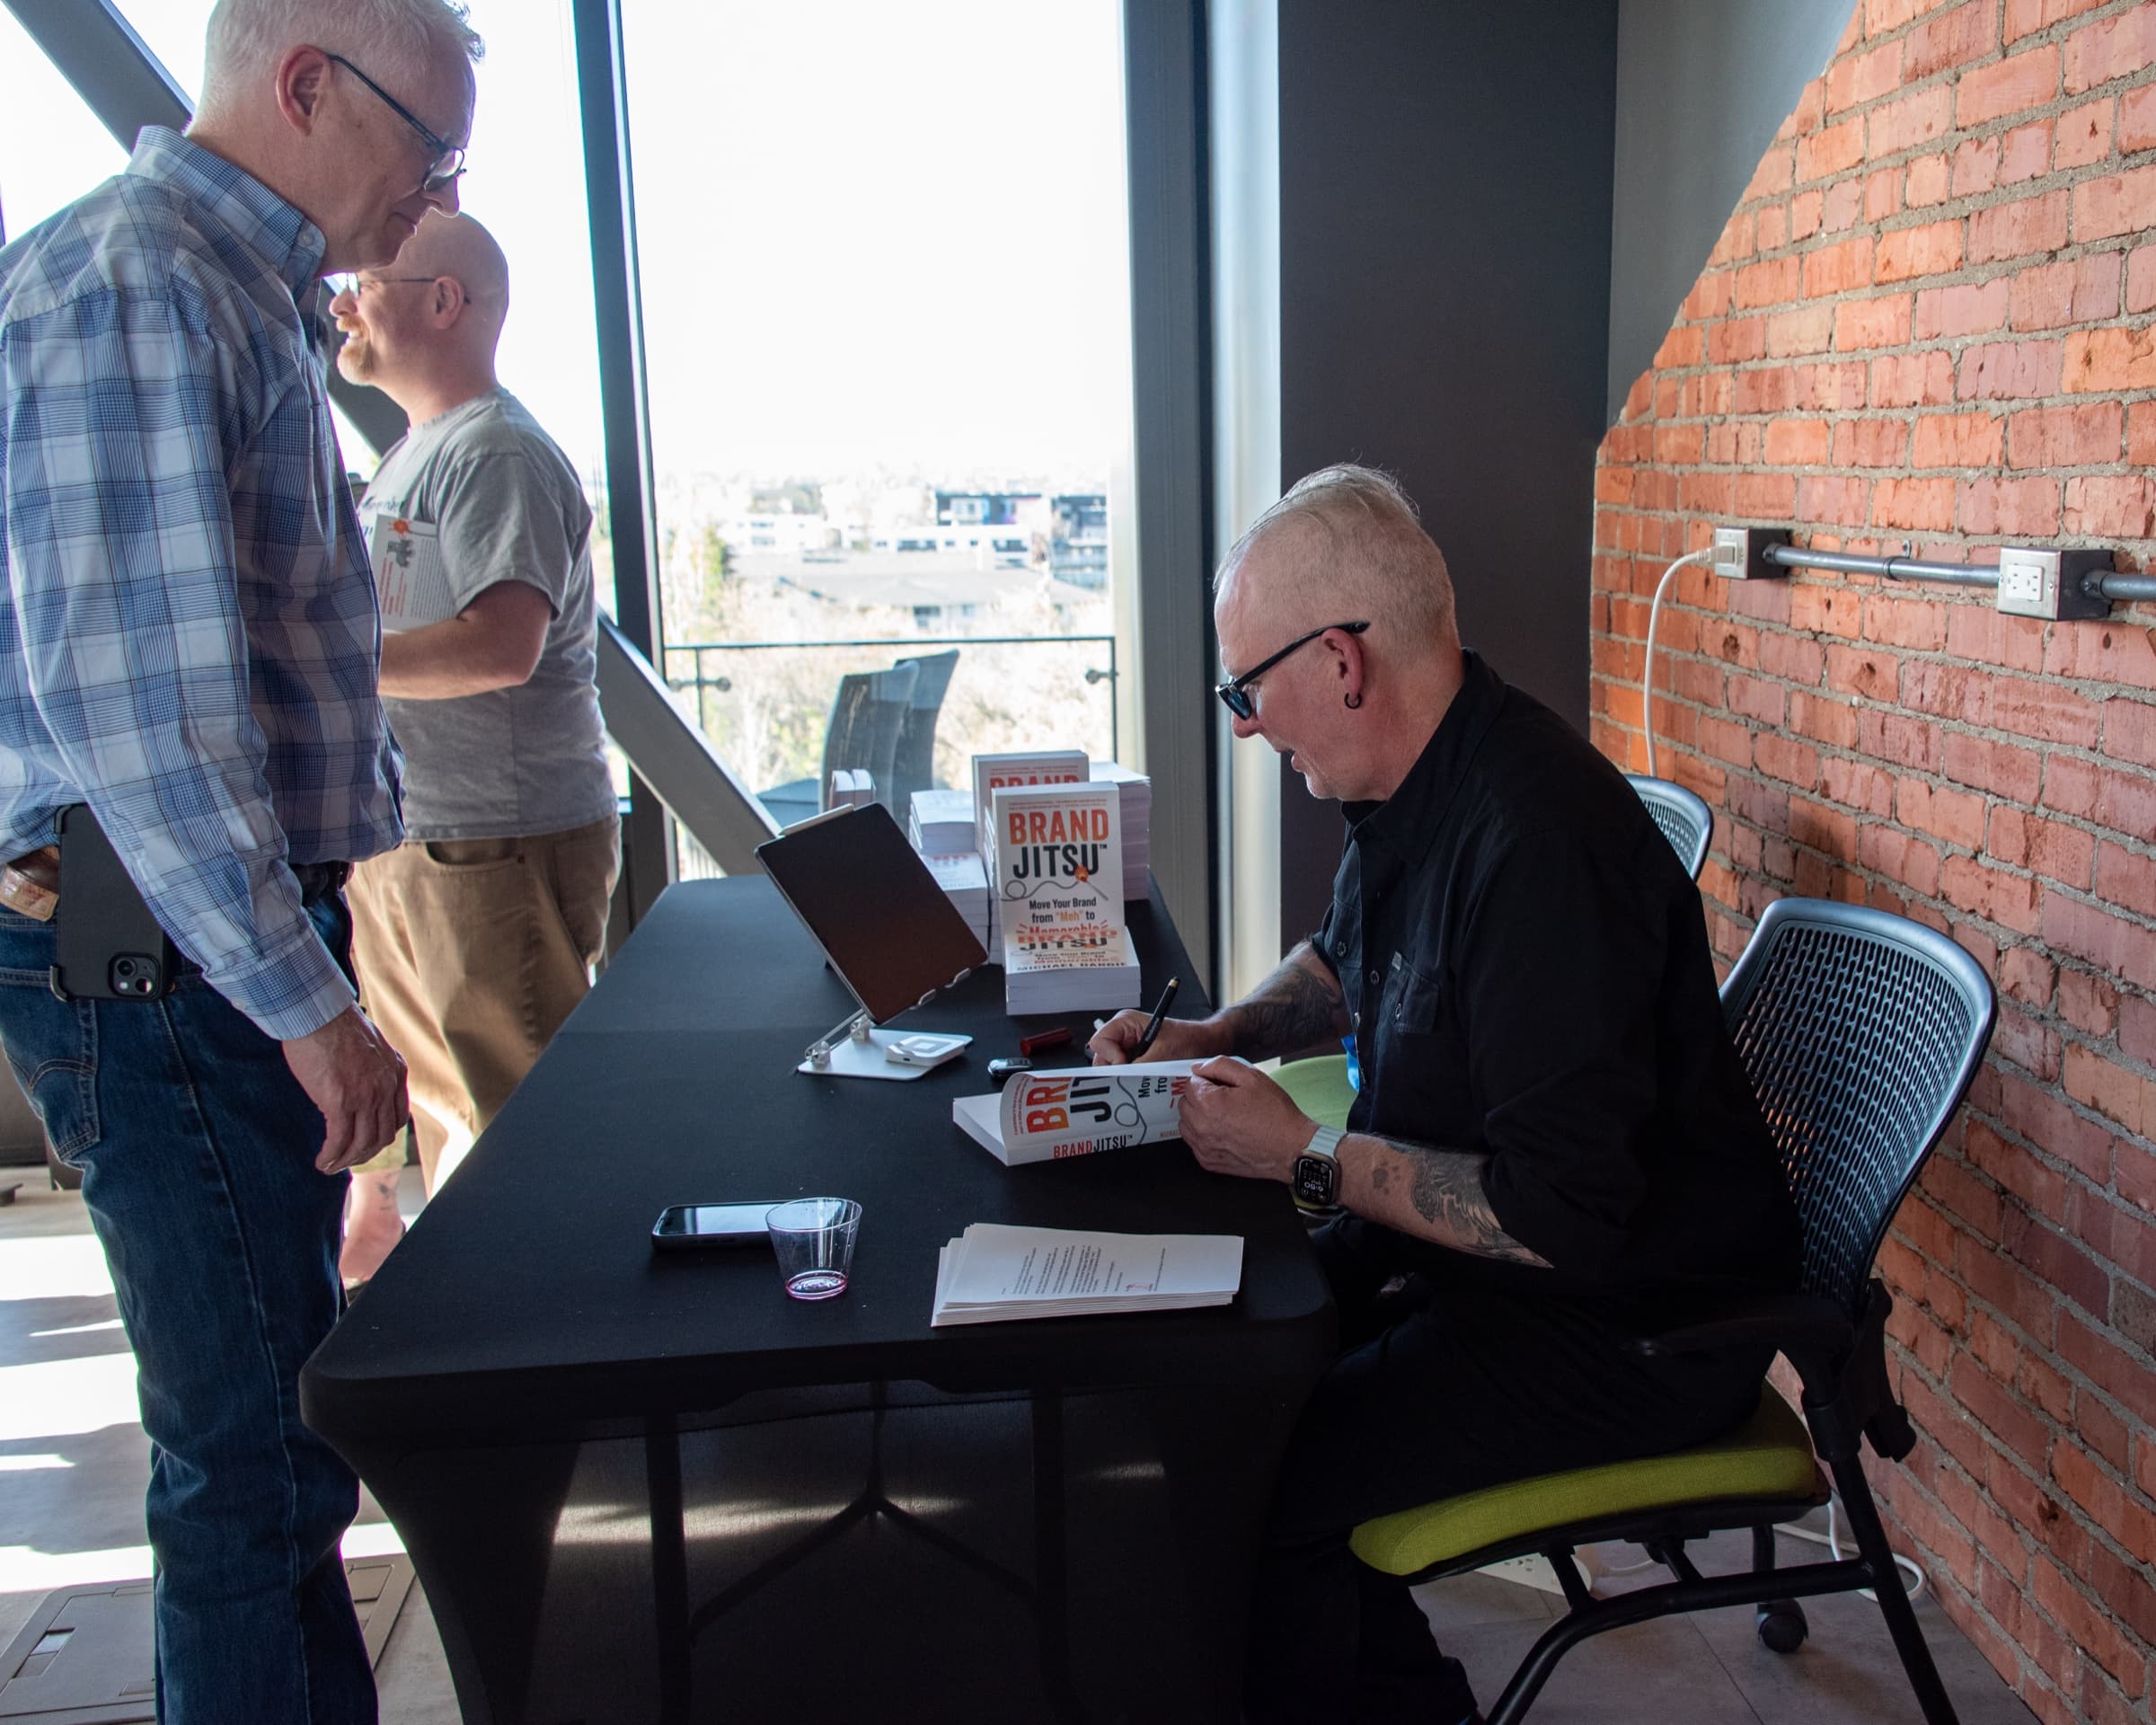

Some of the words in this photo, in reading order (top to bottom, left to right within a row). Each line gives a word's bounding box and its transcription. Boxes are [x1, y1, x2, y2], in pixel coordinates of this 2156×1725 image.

[1009, 809, 1109, 845] BRAND
[1029, 899, 1051, 910] Move
[1052, 898, 1072, 908] Your
[1073, 898, 1097, 908] Brand
[1032, 914, 1054, 924] from
[1085, 910, 1095, 920] to
[1138, 1075, 1151, 1098] Mov
[1154, 1076, 1167, 1094] fro
